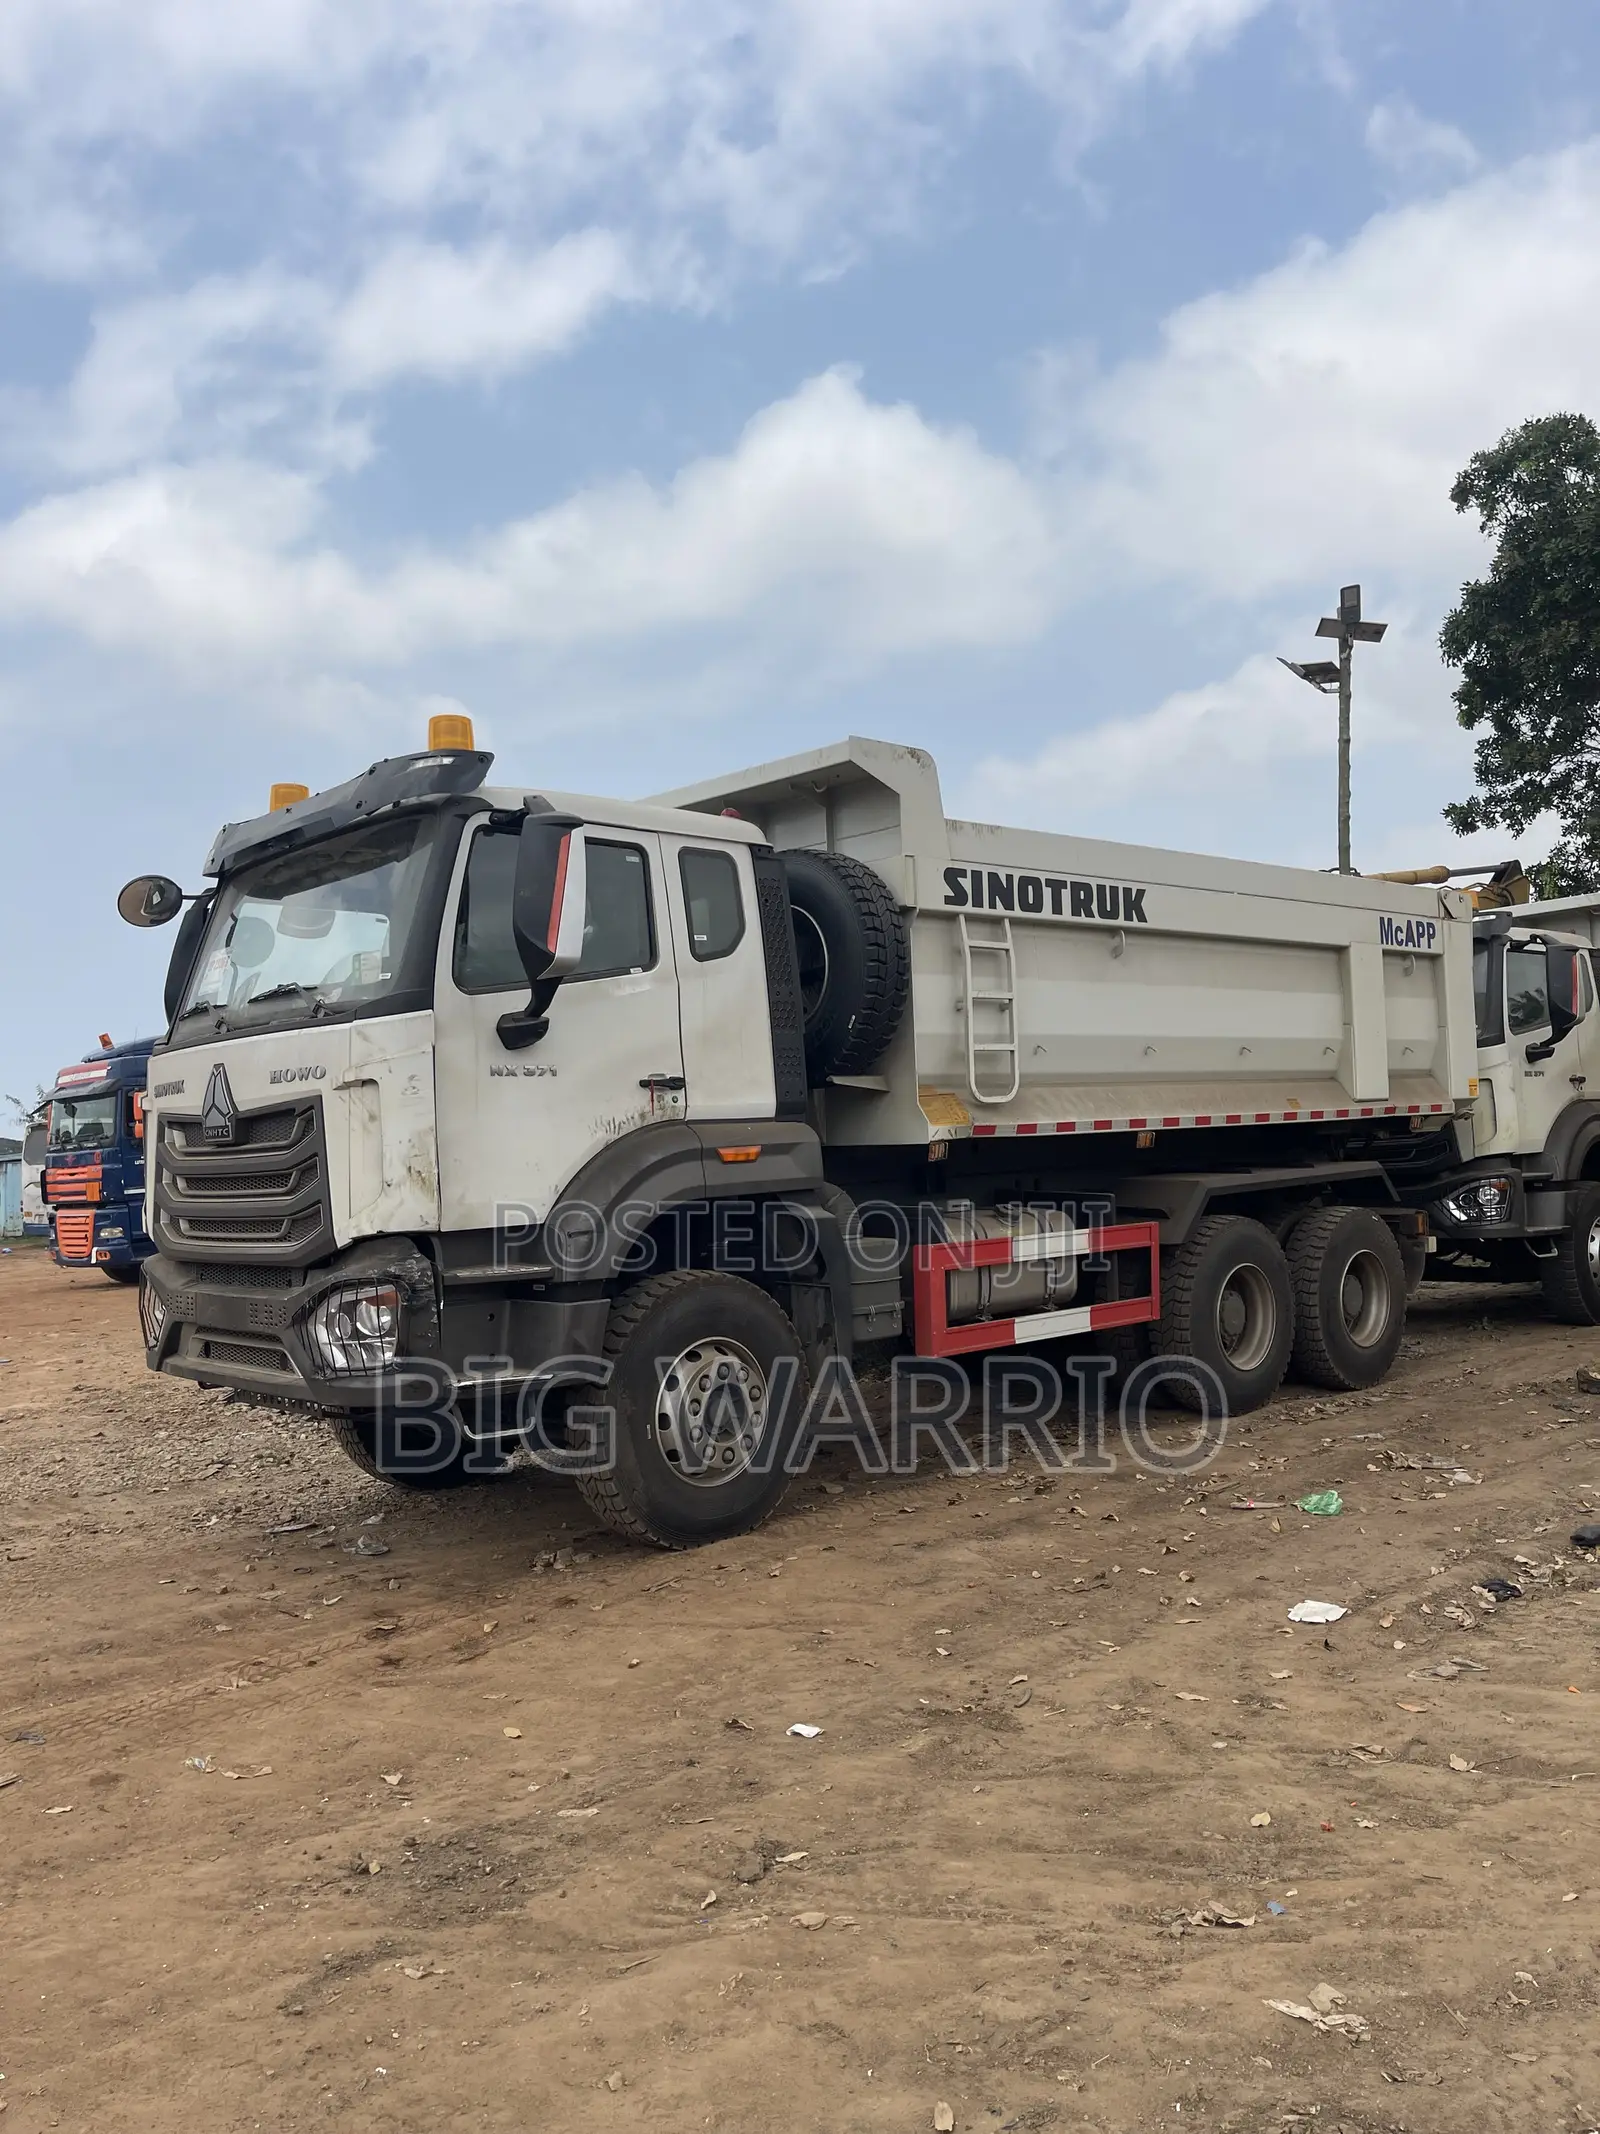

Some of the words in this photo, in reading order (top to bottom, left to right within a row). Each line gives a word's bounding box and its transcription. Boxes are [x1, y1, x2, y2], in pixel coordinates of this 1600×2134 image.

[943, 866, 1148, 924] SINOTRUK
[1379, 916, 1436, 949] McAPP
[269, 1065, 327, 1084] HOWO
[489, 1065, 518, 1077] NX
[523, 1065, 558, 1077] 371
